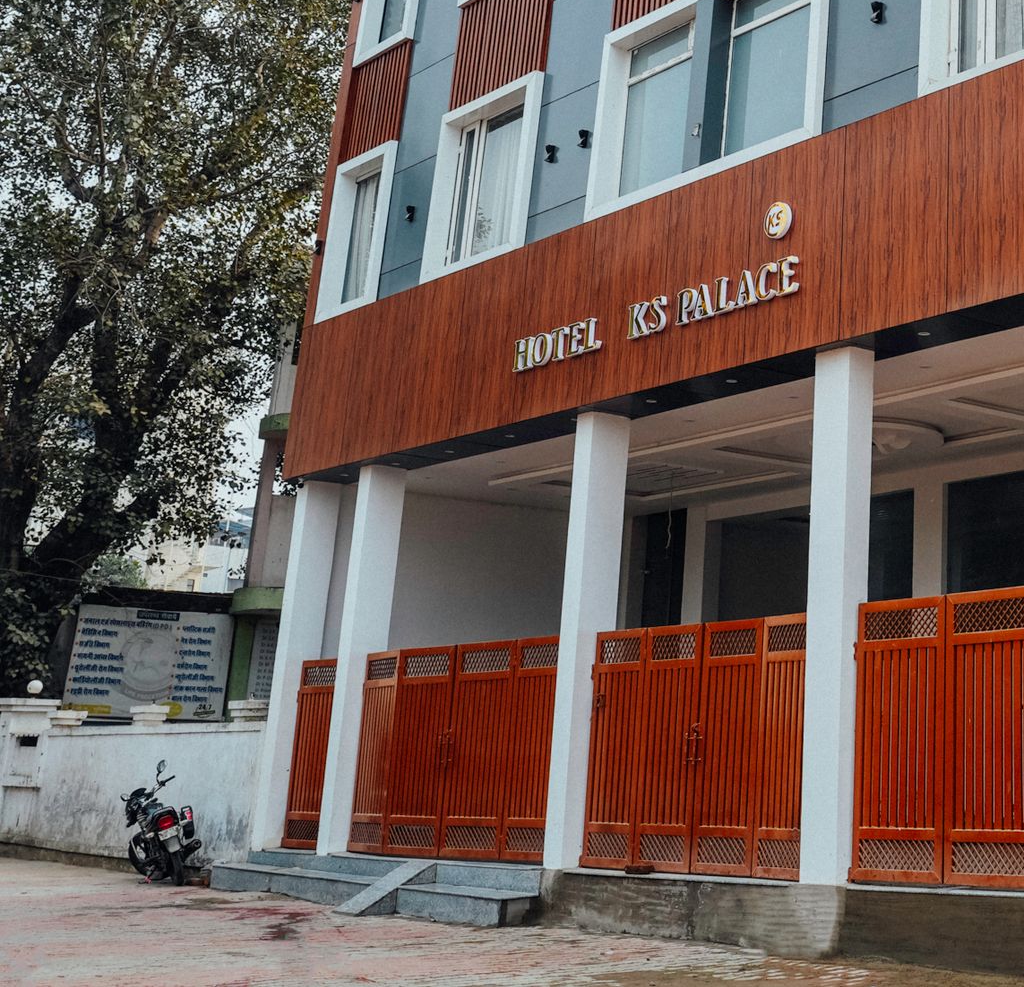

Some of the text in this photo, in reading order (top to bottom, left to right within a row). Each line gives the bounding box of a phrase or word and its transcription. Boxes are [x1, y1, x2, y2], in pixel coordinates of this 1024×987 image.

[512, 255, 799, 373] HOTEL KS PALACE
